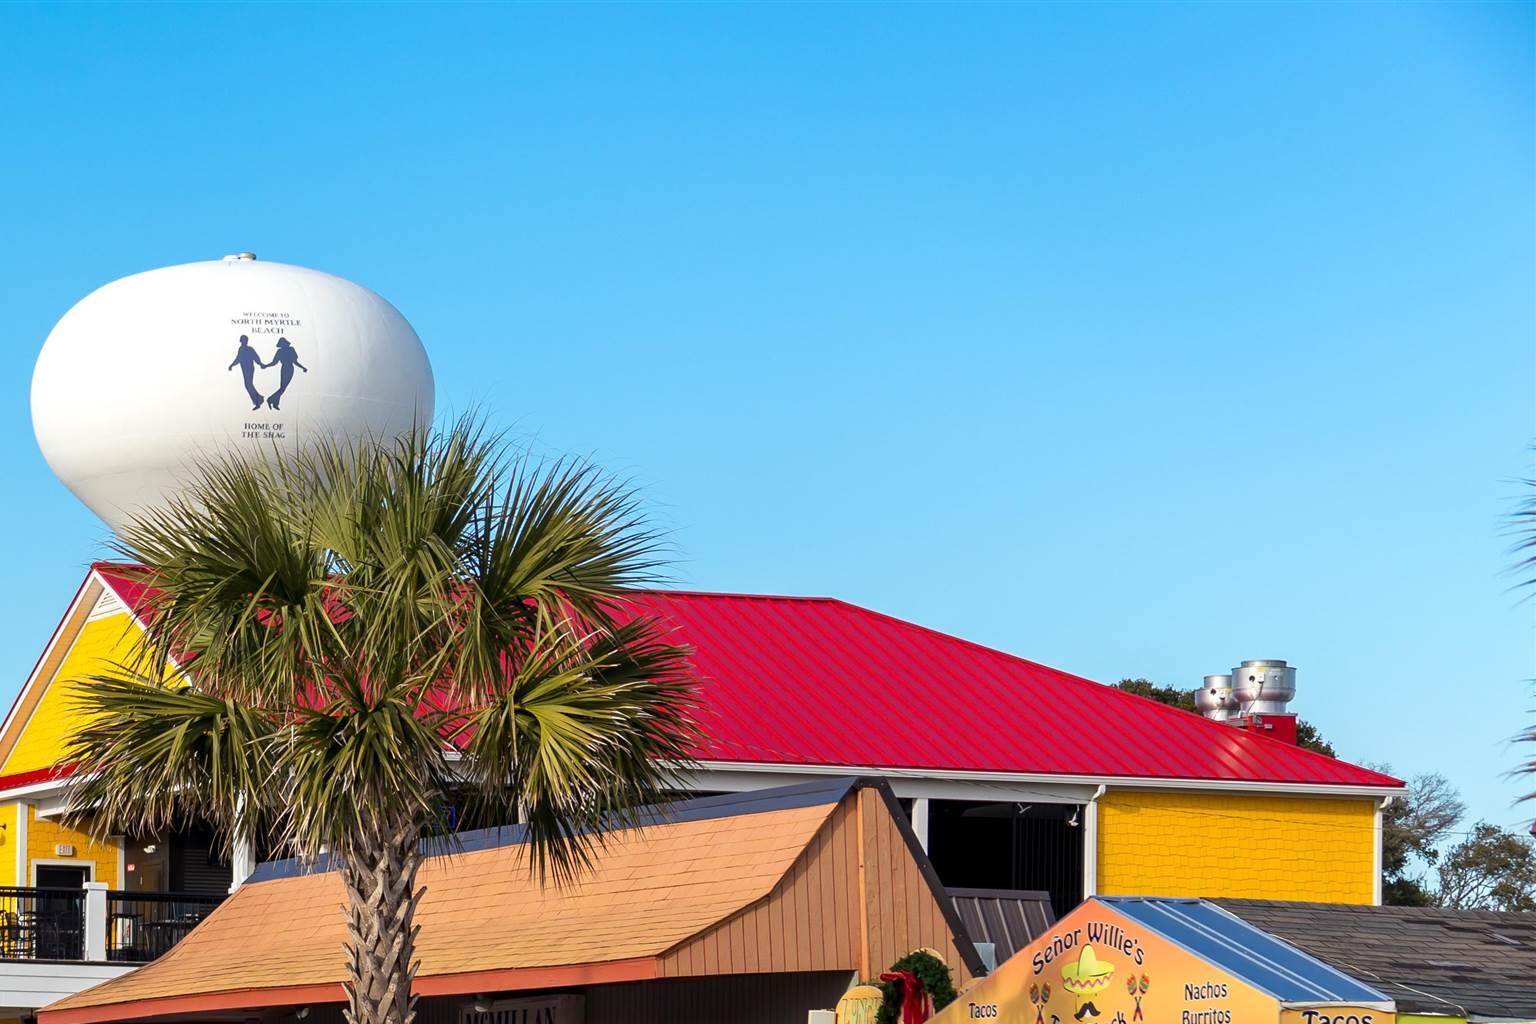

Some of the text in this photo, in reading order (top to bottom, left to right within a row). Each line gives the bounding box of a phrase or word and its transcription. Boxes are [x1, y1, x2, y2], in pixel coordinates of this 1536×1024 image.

[263, 431, 285, 439] SHAG
[1032, 921, 1145, 976] Señor Willie's
[1184, 982, 1227, 1001] Nachos
[968, 1002, 998, 1019] Tacos
